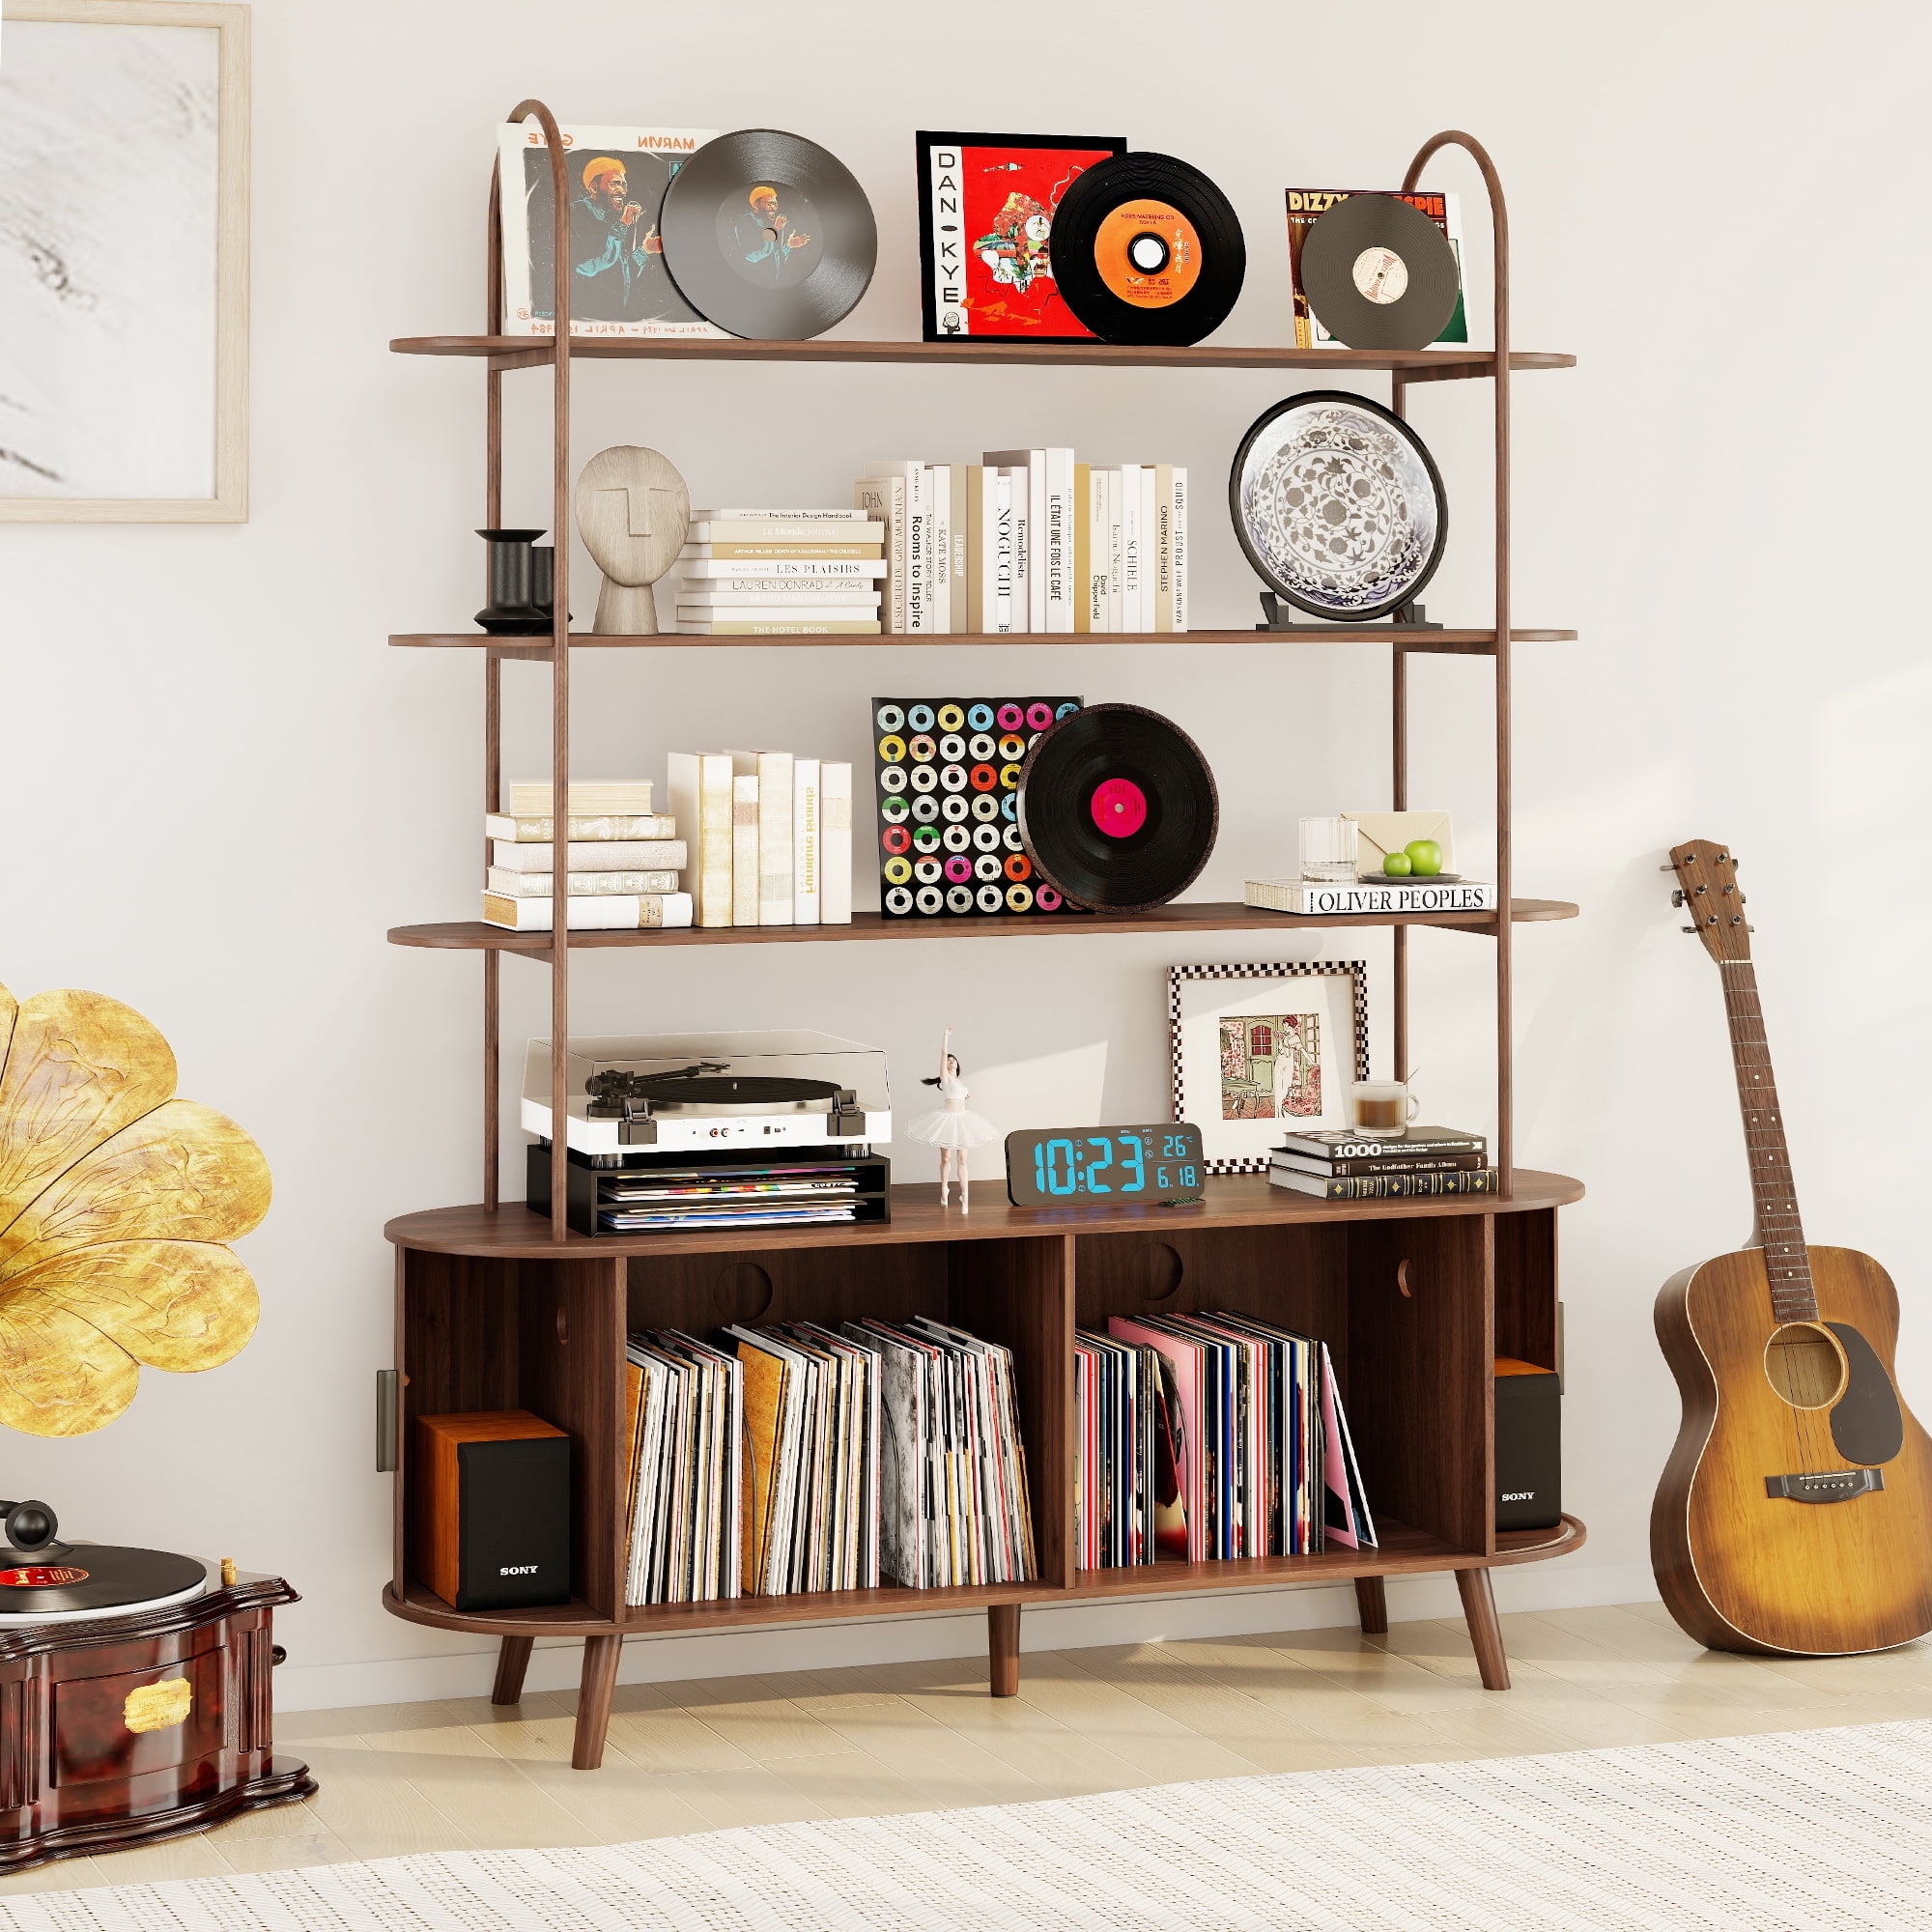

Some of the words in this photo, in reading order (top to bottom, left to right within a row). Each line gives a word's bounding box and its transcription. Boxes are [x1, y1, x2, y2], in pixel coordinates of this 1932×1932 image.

[938, 153, 956, 213] DAN
[941, 242, 959, 303] KYE
[862, 491, 883, 510] JOHN
[1175, 482, 1183, 510] SQUID
[1050, 504, 1063, 527] ÉTAIT
[912, 516, 923, 560] Rooms
[938, 528, 947, 554] KATE
[1017, 519, 1027, 579] Remodelista
[1050, 529, 1061, 546] UNE
[1175, 529, 1183, 566] PROUST
[997, 507, 1011, 597] NOGUCHI
[1050, 548, 1061, 566] FOIS
[777, 564, 798, 574] LES
[804, 564, 861, 574] PLAISIRS
[912, 564, 923, 579] to
[938, 556, 947, 584] MOSS
[1050, 568, 1061, 578] LE
[1127, 539, 1138, 591] SCHIELE
[732, 580, 776, 590] LAUREN
[779, 580, 823, 590] CONRAD
[1050, 580, 1063, 601] CAFÉ
[1092, 575, 1100, 620] Chipperfield
[909, 582, 923, 628] Inspire
[1318, 891, 1392, 913] OLIVER
[1399, 888, 1484, 910] PEOPLES
[1334, 1143, 1382, 1158] 1000
[1034, 1135, 1146, 1195] 10:23
[1501, 1492, 1536, 1502] SONY
[499, 1565, 539, 1576] SONY
